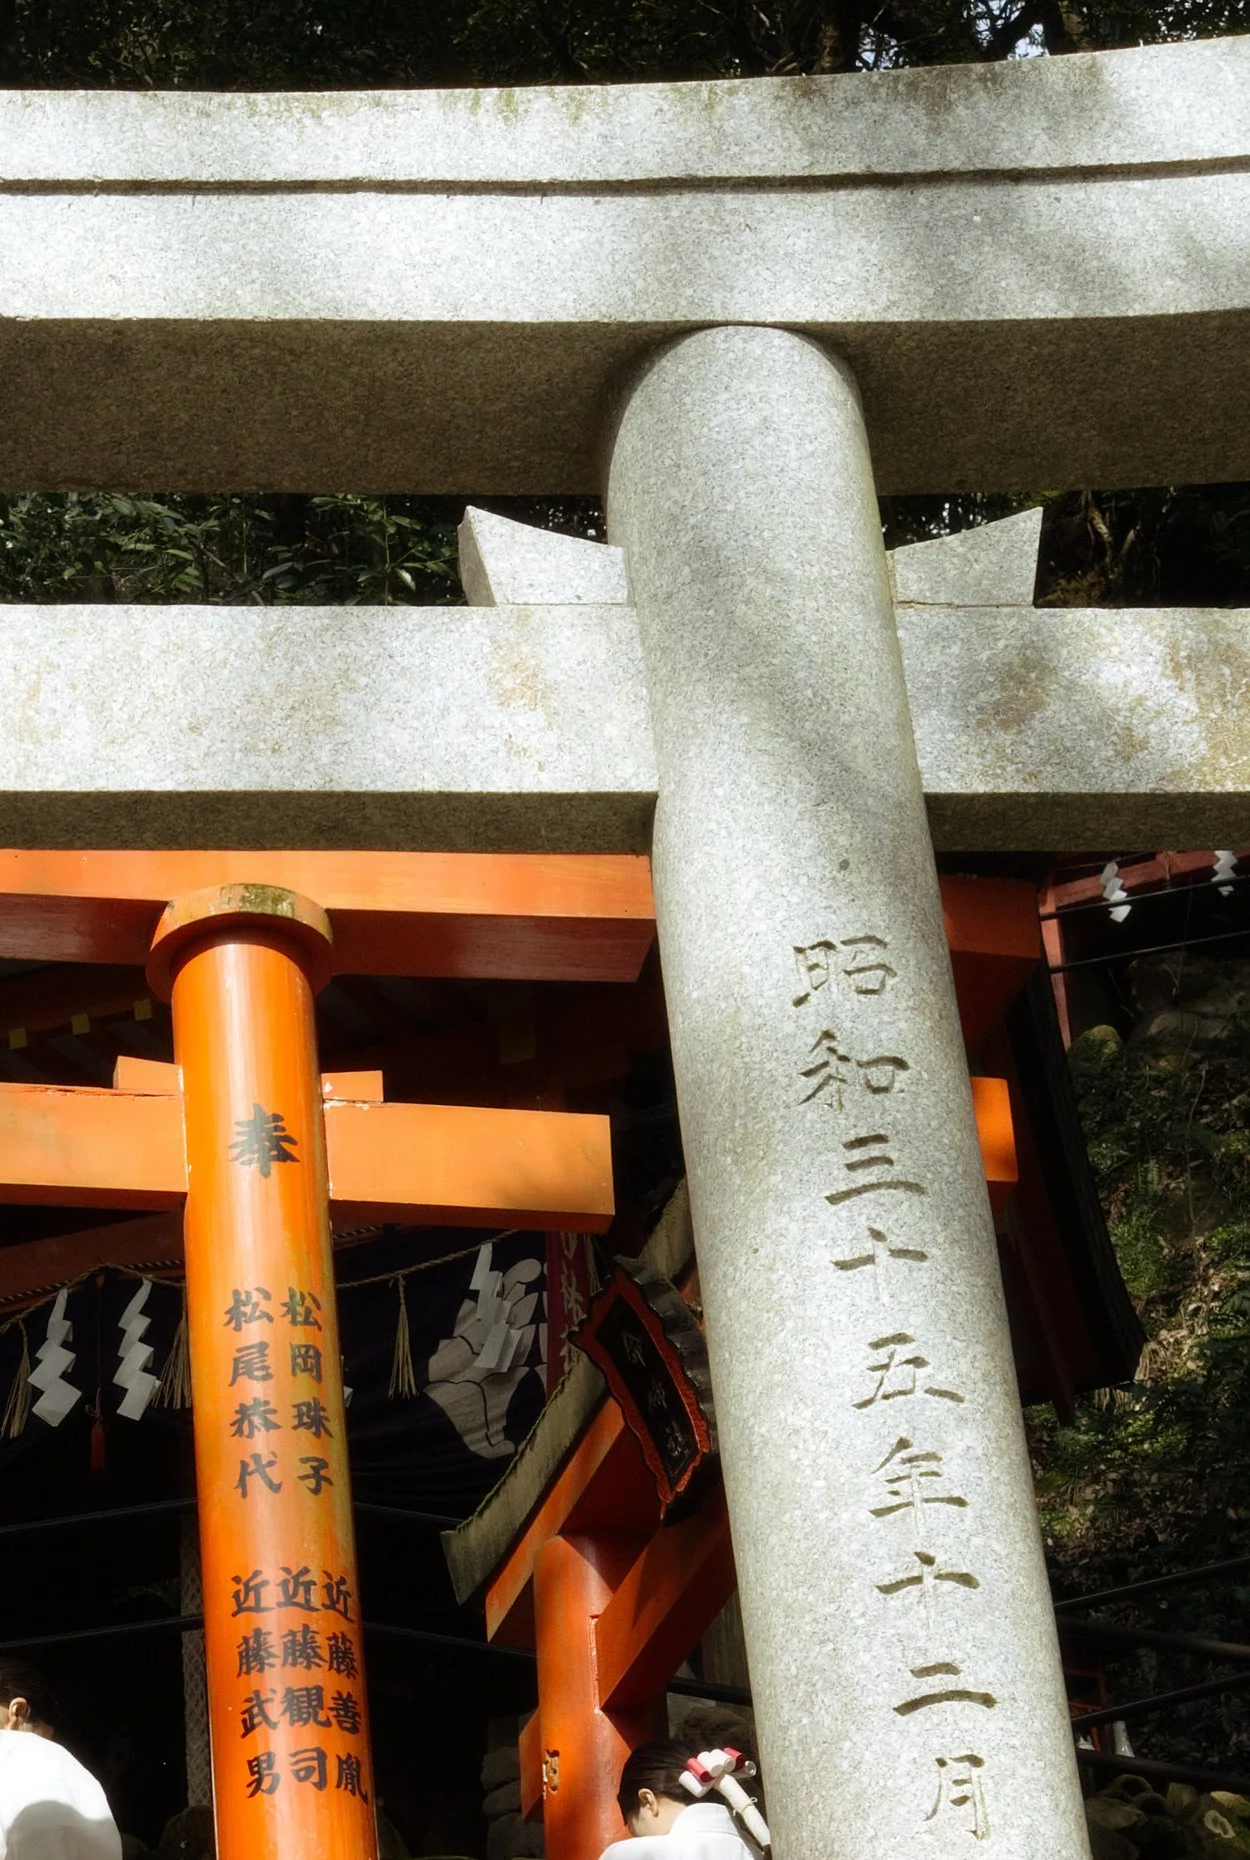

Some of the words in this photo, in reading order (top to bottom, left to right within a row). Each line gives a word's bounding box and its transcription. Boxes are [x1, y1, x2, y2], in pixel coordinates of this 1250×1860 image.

[227, 1103, 301, 1179] 奉
[223, 1286, 283, 1499] 松尾恭代
[280, 1286, 334, 1497] 松岡珠子
[231, 1569, 280, 1799] 近藤武男
[275, 1566, 333, 1792] 近藤観司
[322, 1570, 368, 1805] 近藤善胤
